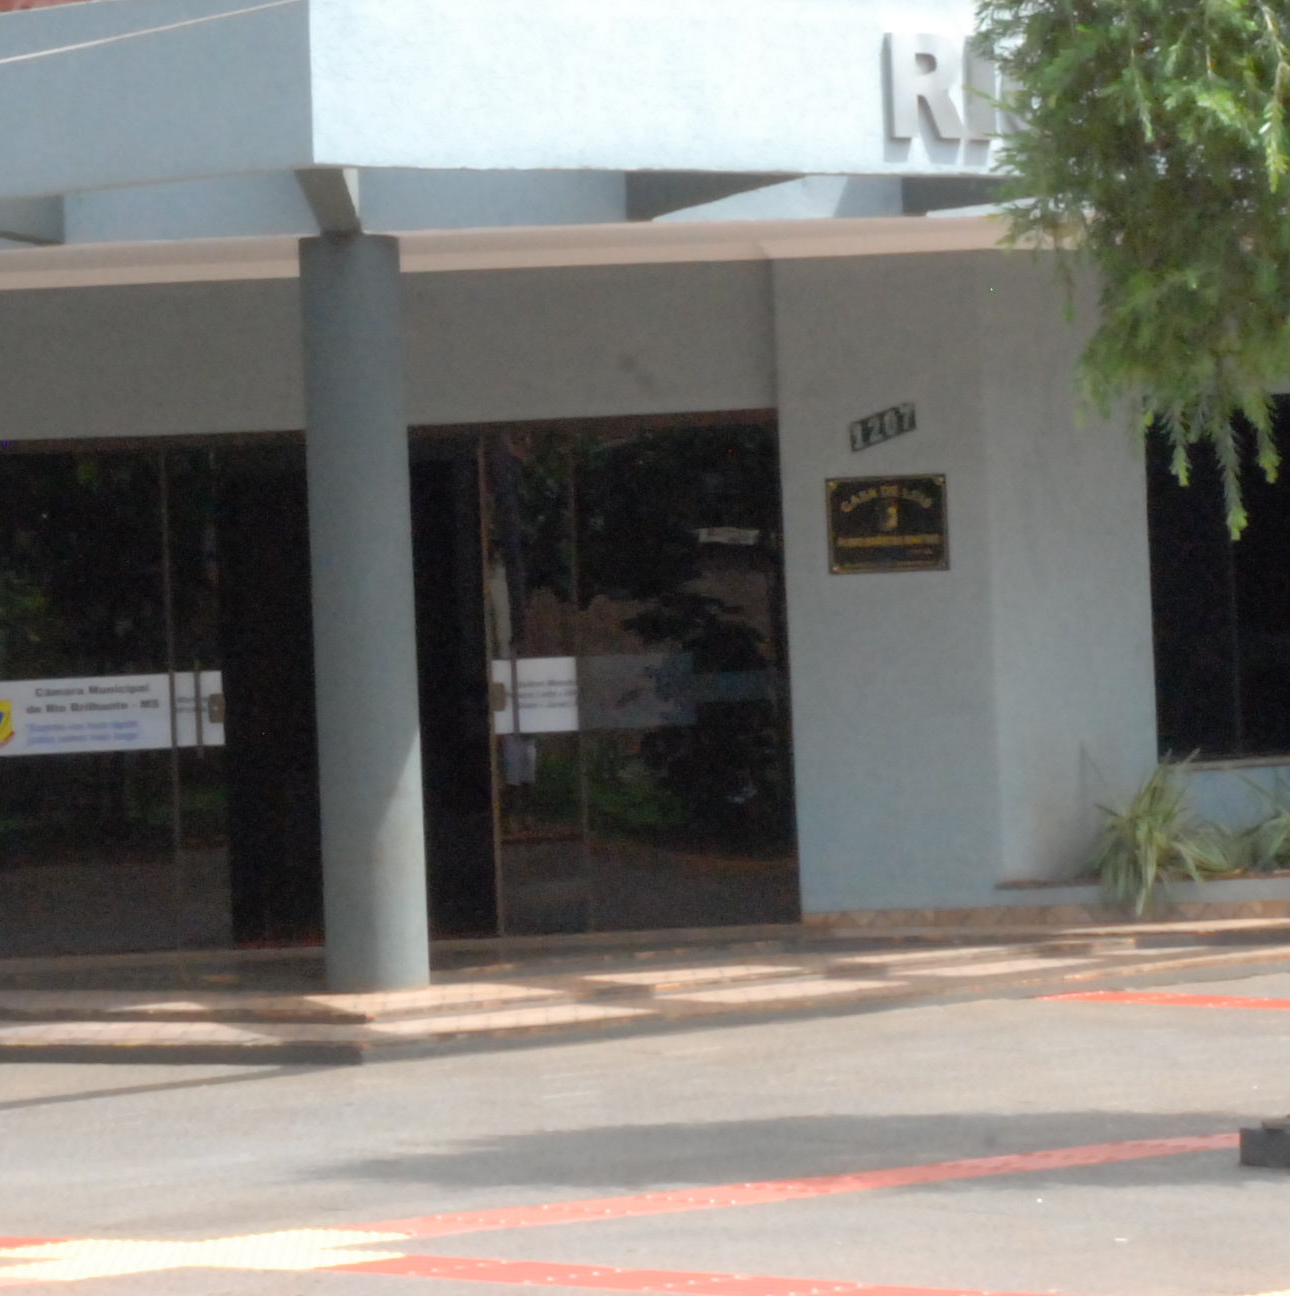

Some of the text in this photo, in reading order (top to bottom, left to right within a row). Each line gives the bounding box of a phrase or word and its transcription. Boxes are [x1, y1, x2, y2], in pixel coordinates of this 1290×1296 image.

[848, 403, 915, 450] 1207
[88, 683, 150, 695] Municipal
[46, 703, 67, 713] Rio
